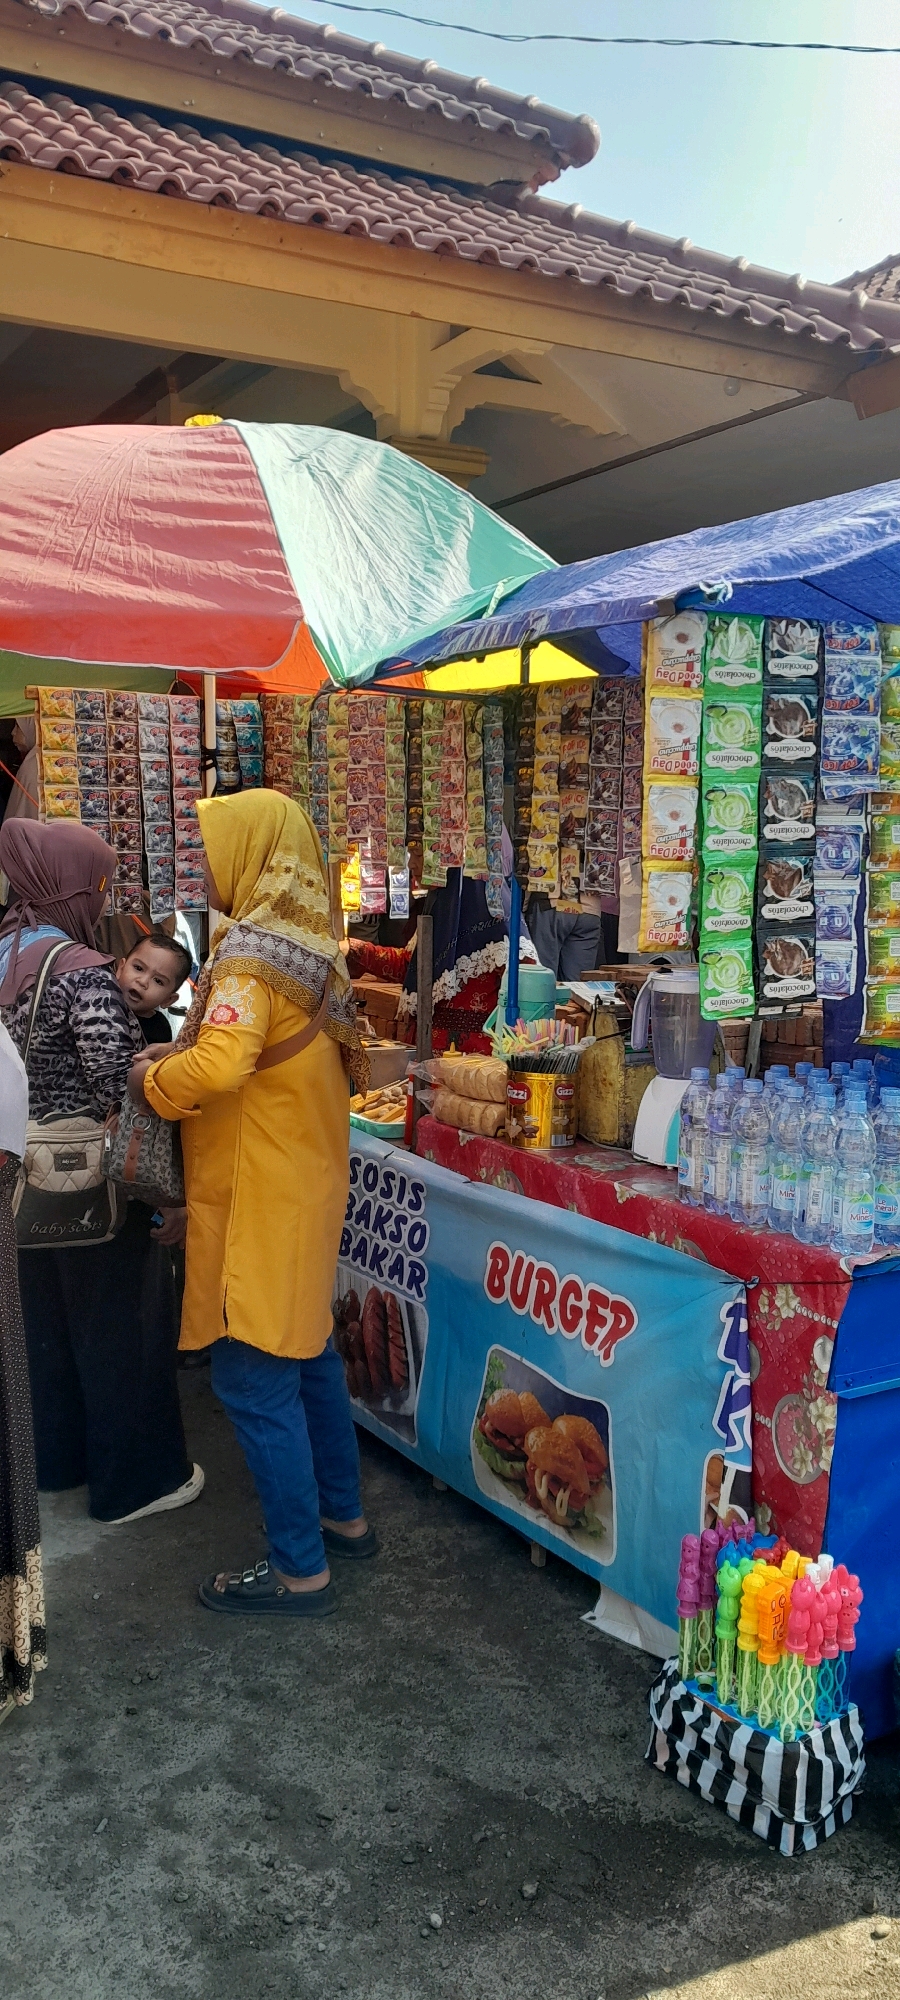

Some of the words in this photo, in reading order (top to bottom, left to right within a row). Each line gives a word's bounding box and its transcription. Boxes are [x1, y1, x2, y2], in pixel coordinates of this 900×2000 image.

[655, 667, 676, 683] Day
[677, 672, 703, 684] Good
[652, 757, 672, 772] Day
[674, 760, 698, 772] Good
[650, 844, 670, 858] Day
[671, 846, 695, 858] Good
[648, 929, 666, 943] Day
[668, 930, 688, 942] Good
[349, 1156, 425, 1212] SOSIS
[339, 1226, 426, 1299] BAKAR
[486, 1245, 636, 1362] BURGER
